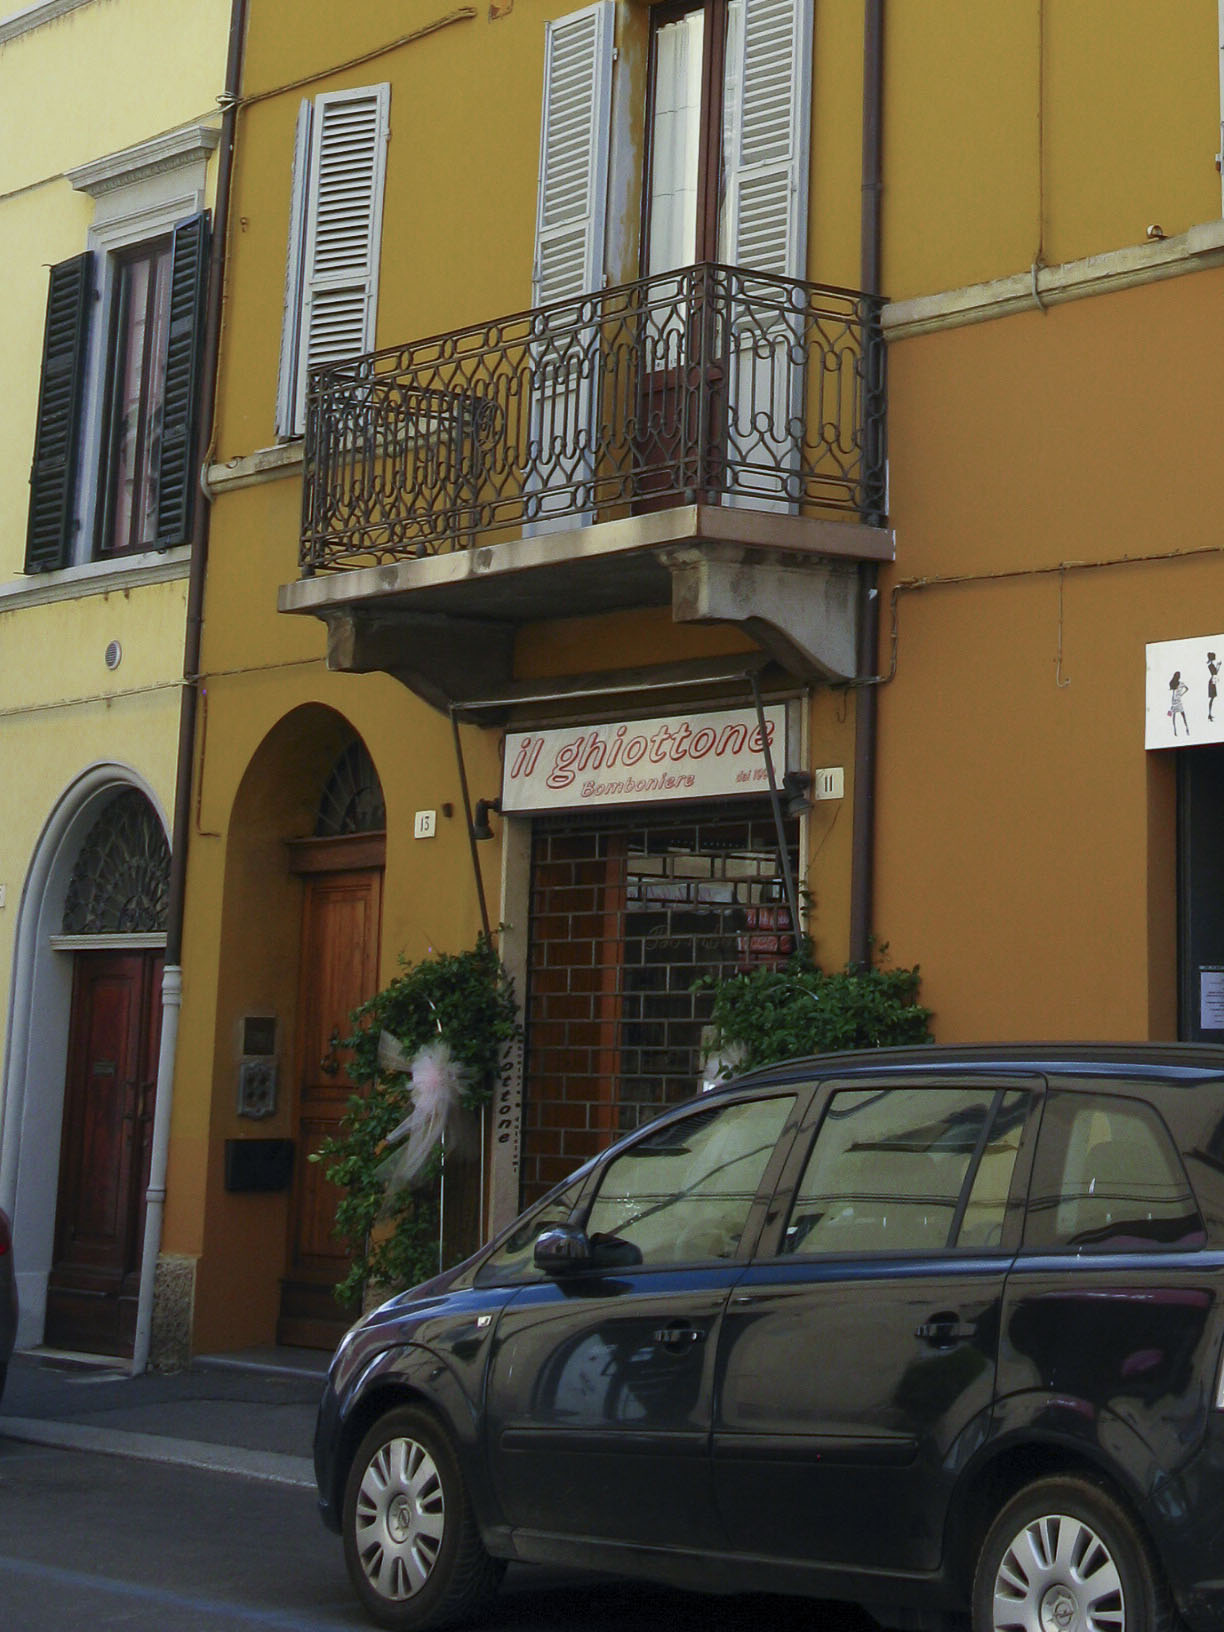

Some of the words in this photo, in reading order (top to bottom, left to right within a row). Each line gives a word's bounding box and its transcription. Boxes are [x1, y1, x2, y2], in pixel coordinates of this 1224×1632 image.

[510, 736, 545, 779] il
[545, 720, 776, 790] ghiottone
[580, 772, 696, 799] Bomboniere
[420, 815, 430, 833] 13
